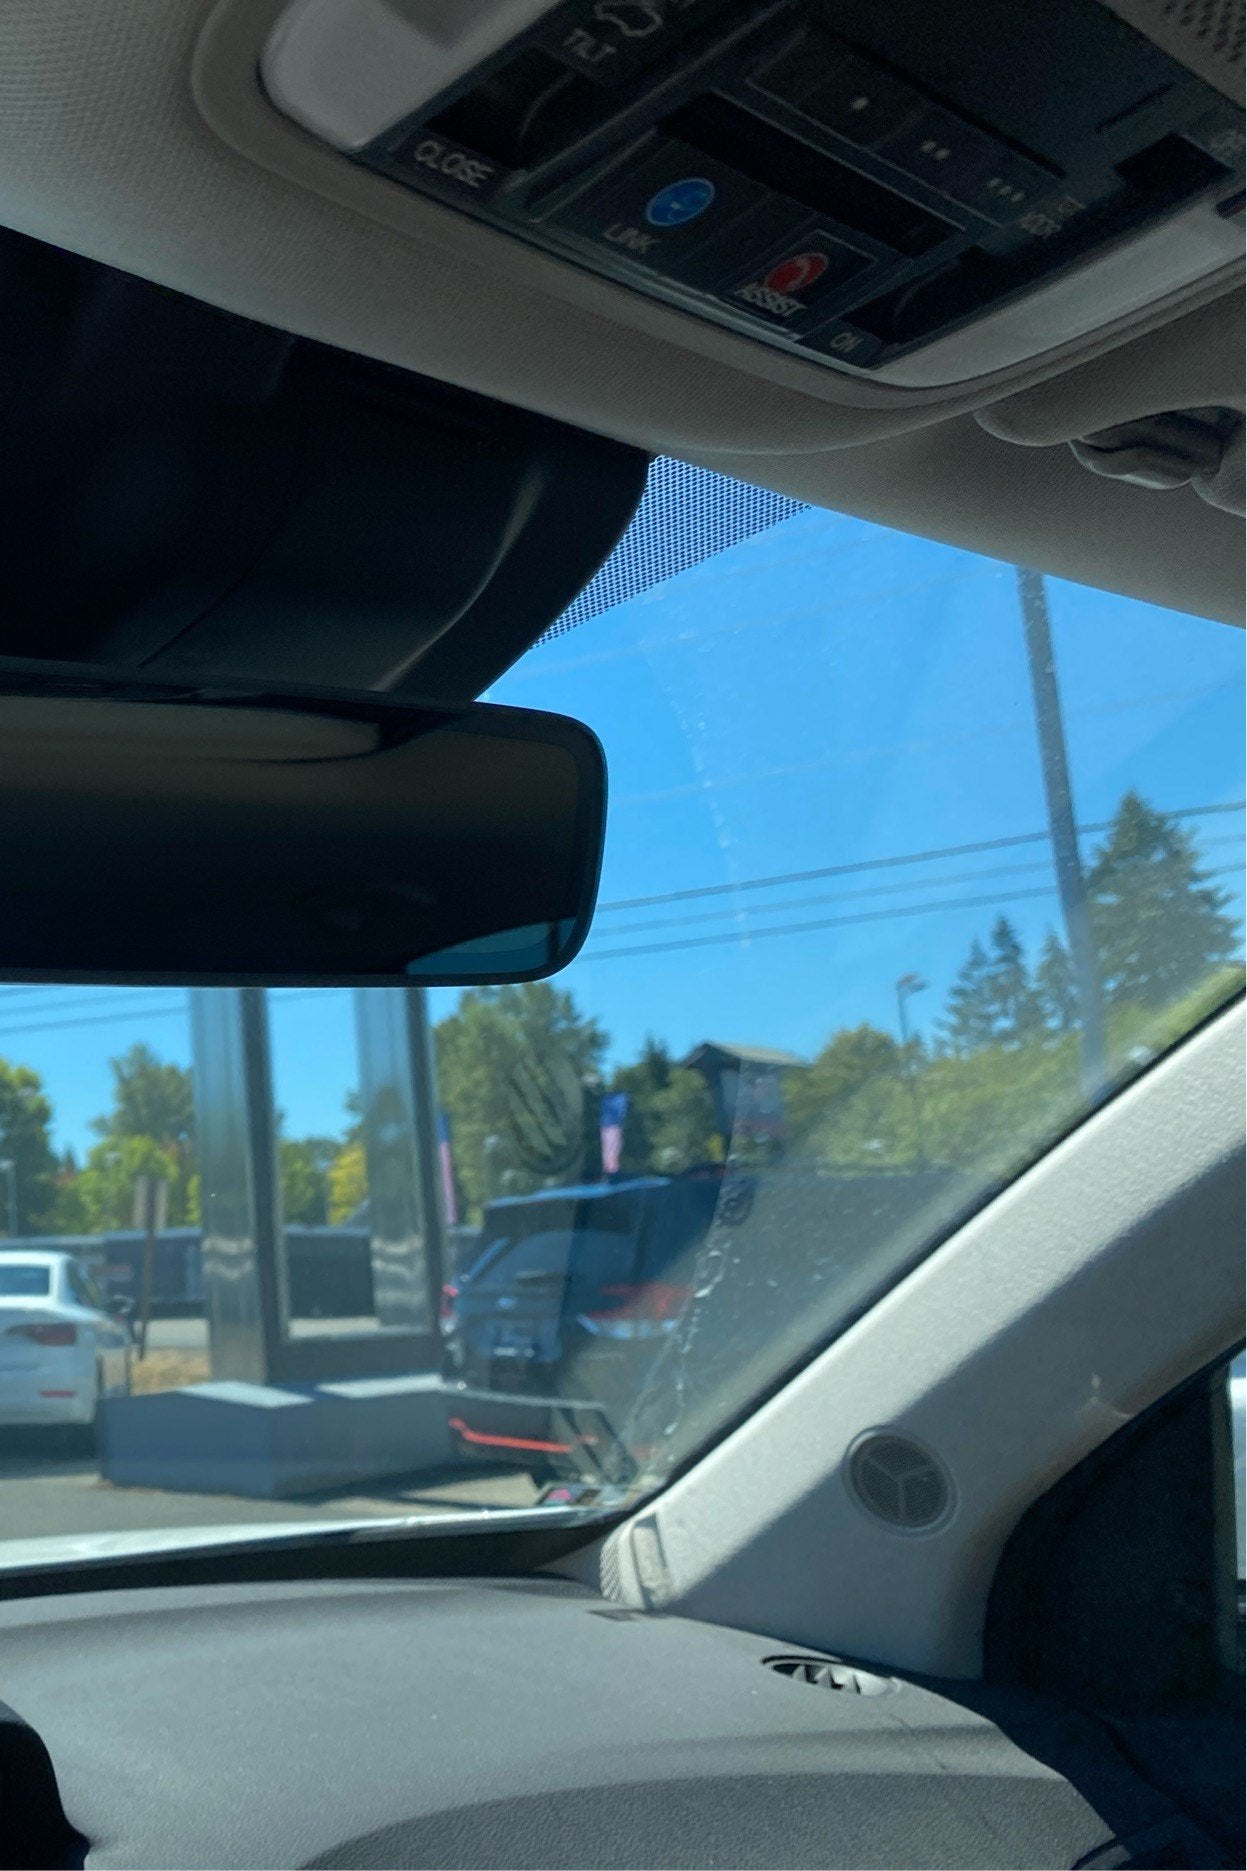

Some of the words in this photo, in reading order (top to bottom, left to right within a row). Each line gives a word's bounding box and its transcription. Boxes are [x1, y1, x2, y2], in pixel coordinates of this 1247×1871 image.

[563, 28, 618, 63] TILT
[414, 139, 497, 189] CLOSE
[602, 222, 661, 255] LINK
[733, 280, 809, 318] ASSIST
